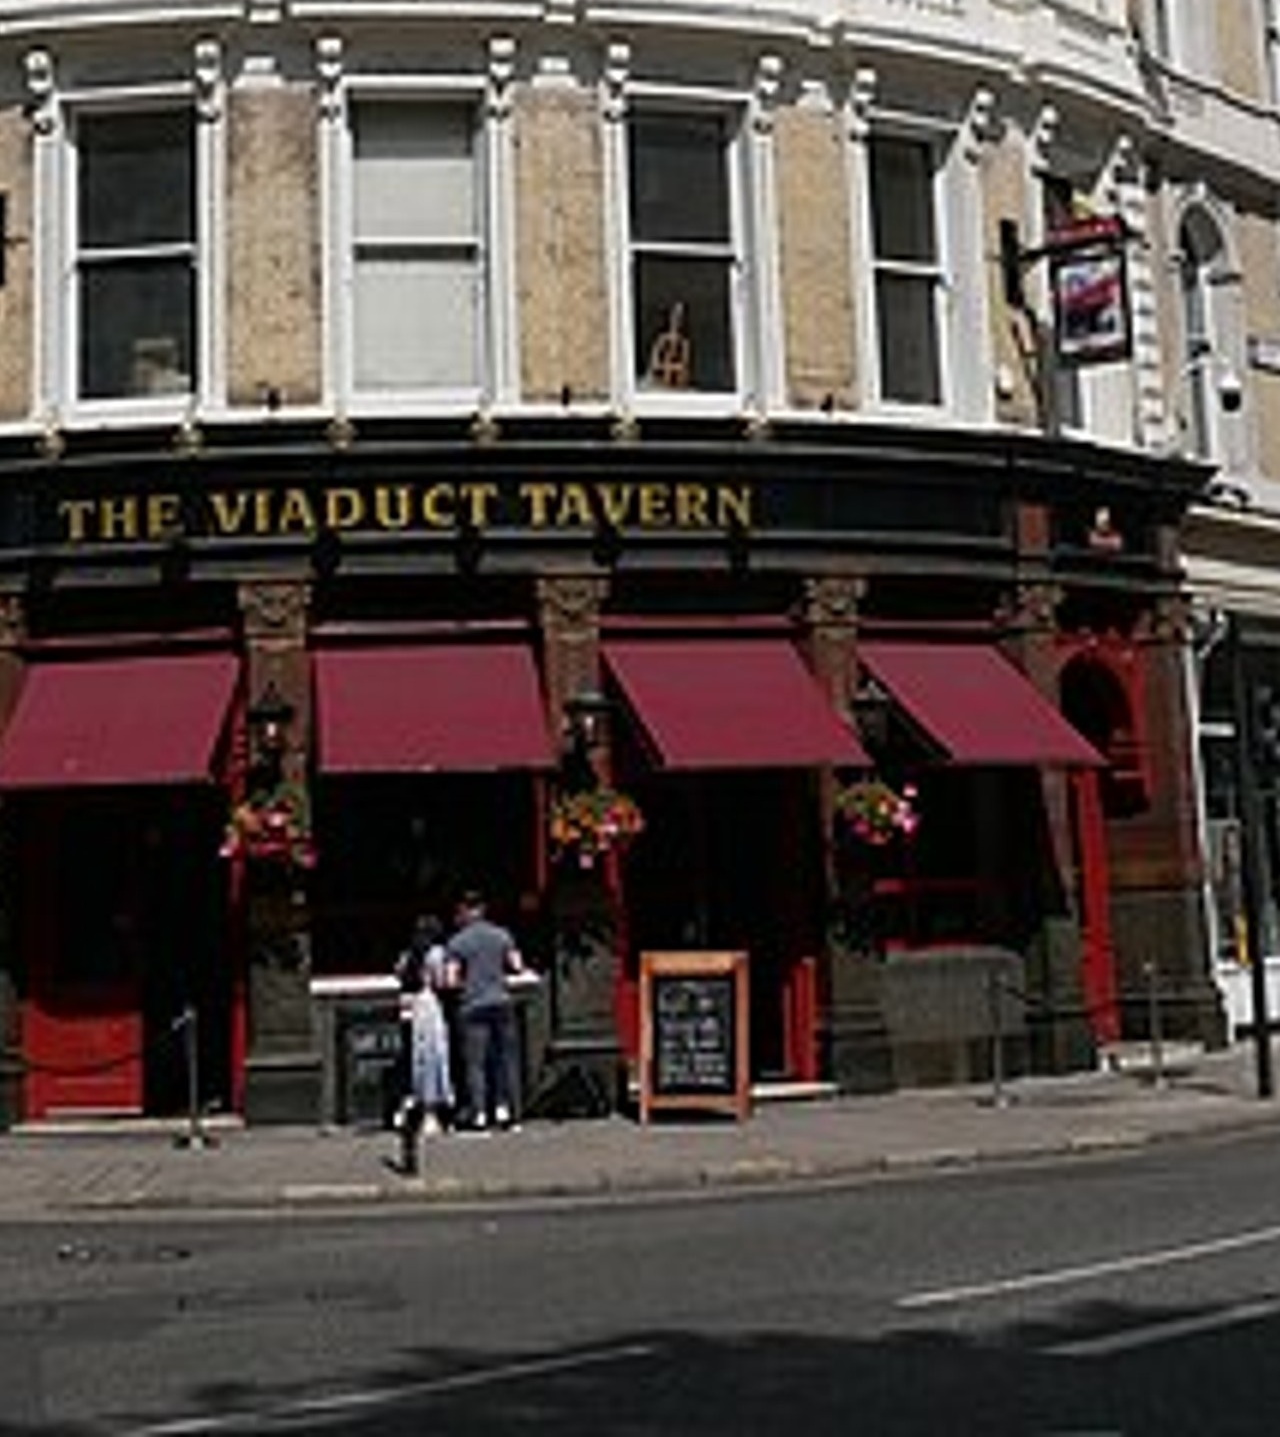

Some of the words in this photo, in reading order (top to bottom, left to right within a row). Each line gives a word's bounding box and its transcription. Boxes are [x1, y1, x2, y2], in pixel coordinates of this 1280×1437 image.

[58, 494, 184, 541] THE
[208, 481, 498, 538] VIADUCT
[519, 482, 752, 529] TAVERN
